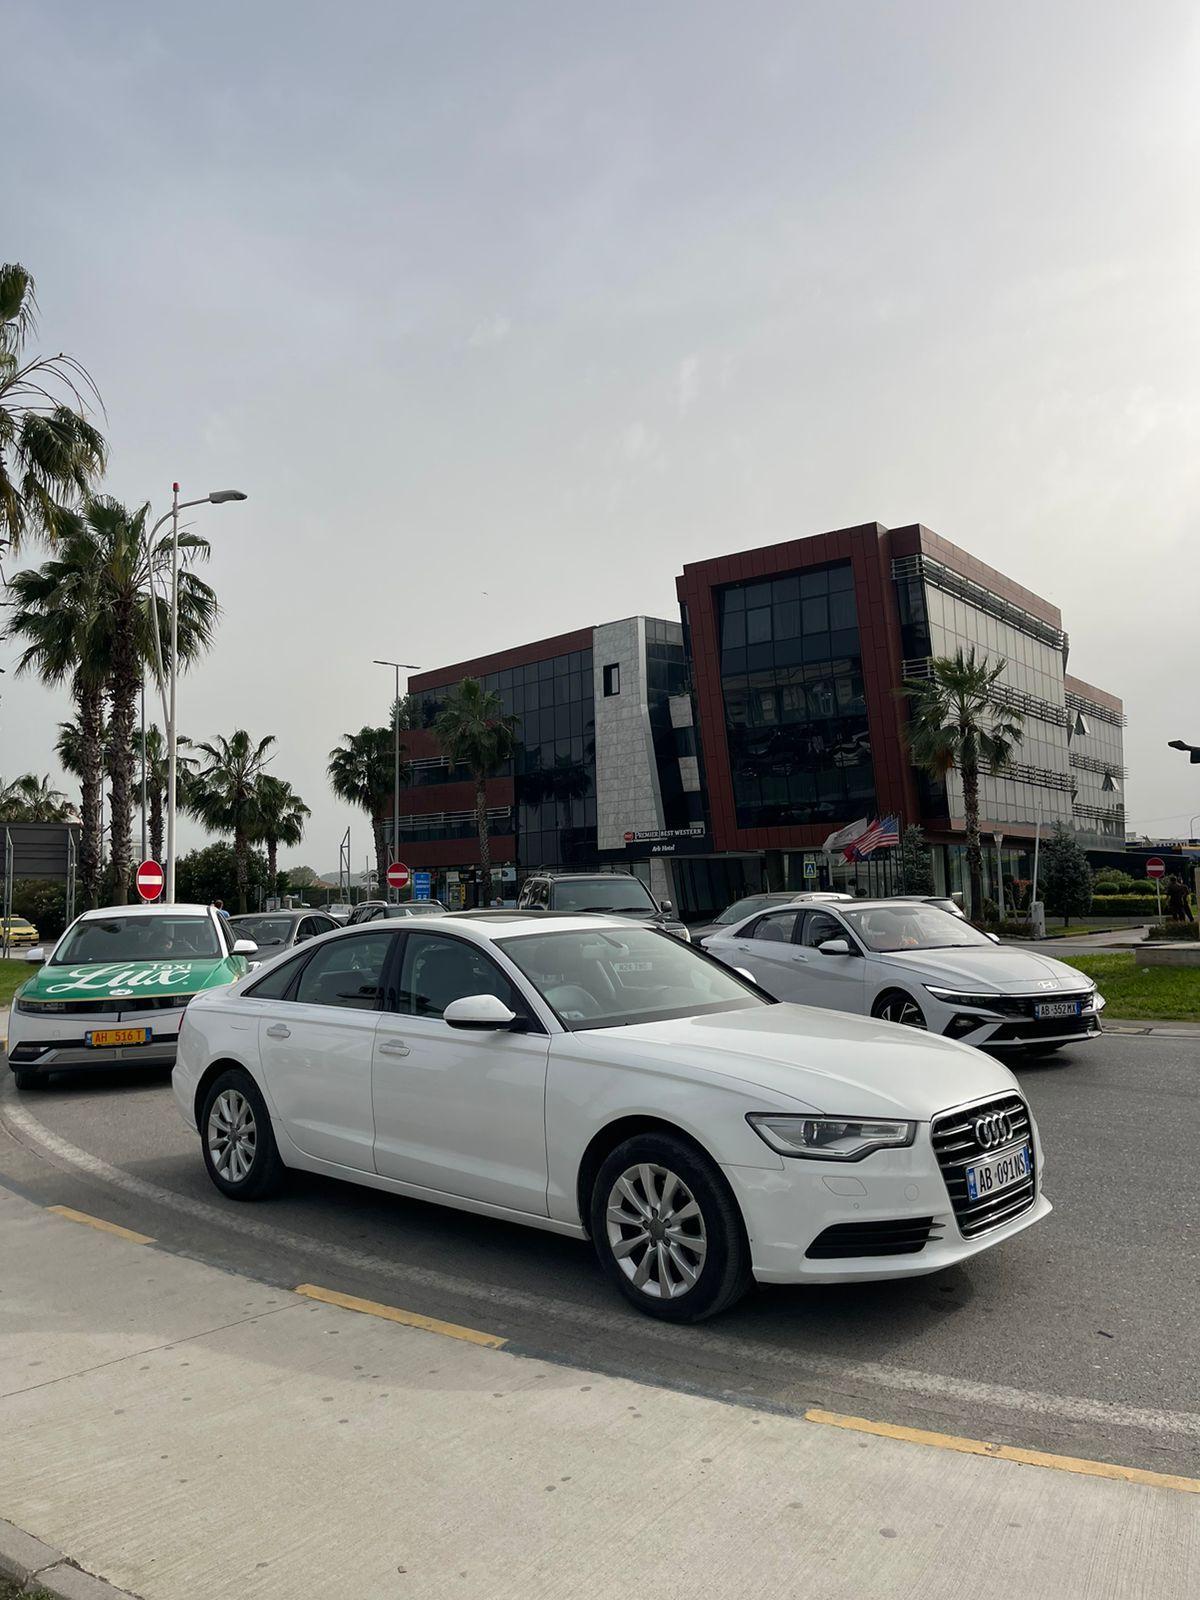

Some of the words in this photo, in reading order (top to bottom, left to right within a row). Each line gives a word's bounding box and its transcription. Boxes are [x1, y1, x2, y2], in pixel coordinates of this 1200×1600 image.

[634, 831, 659, 840] PREMIER
[674, 828, 702, 836] WESTERN
[149, 963, 192, 971] Taxi
[46, 963, 190, 993] Lux
[95, 1031, 108, 1043] AH
[979, 1166, 993, 1193] AB
